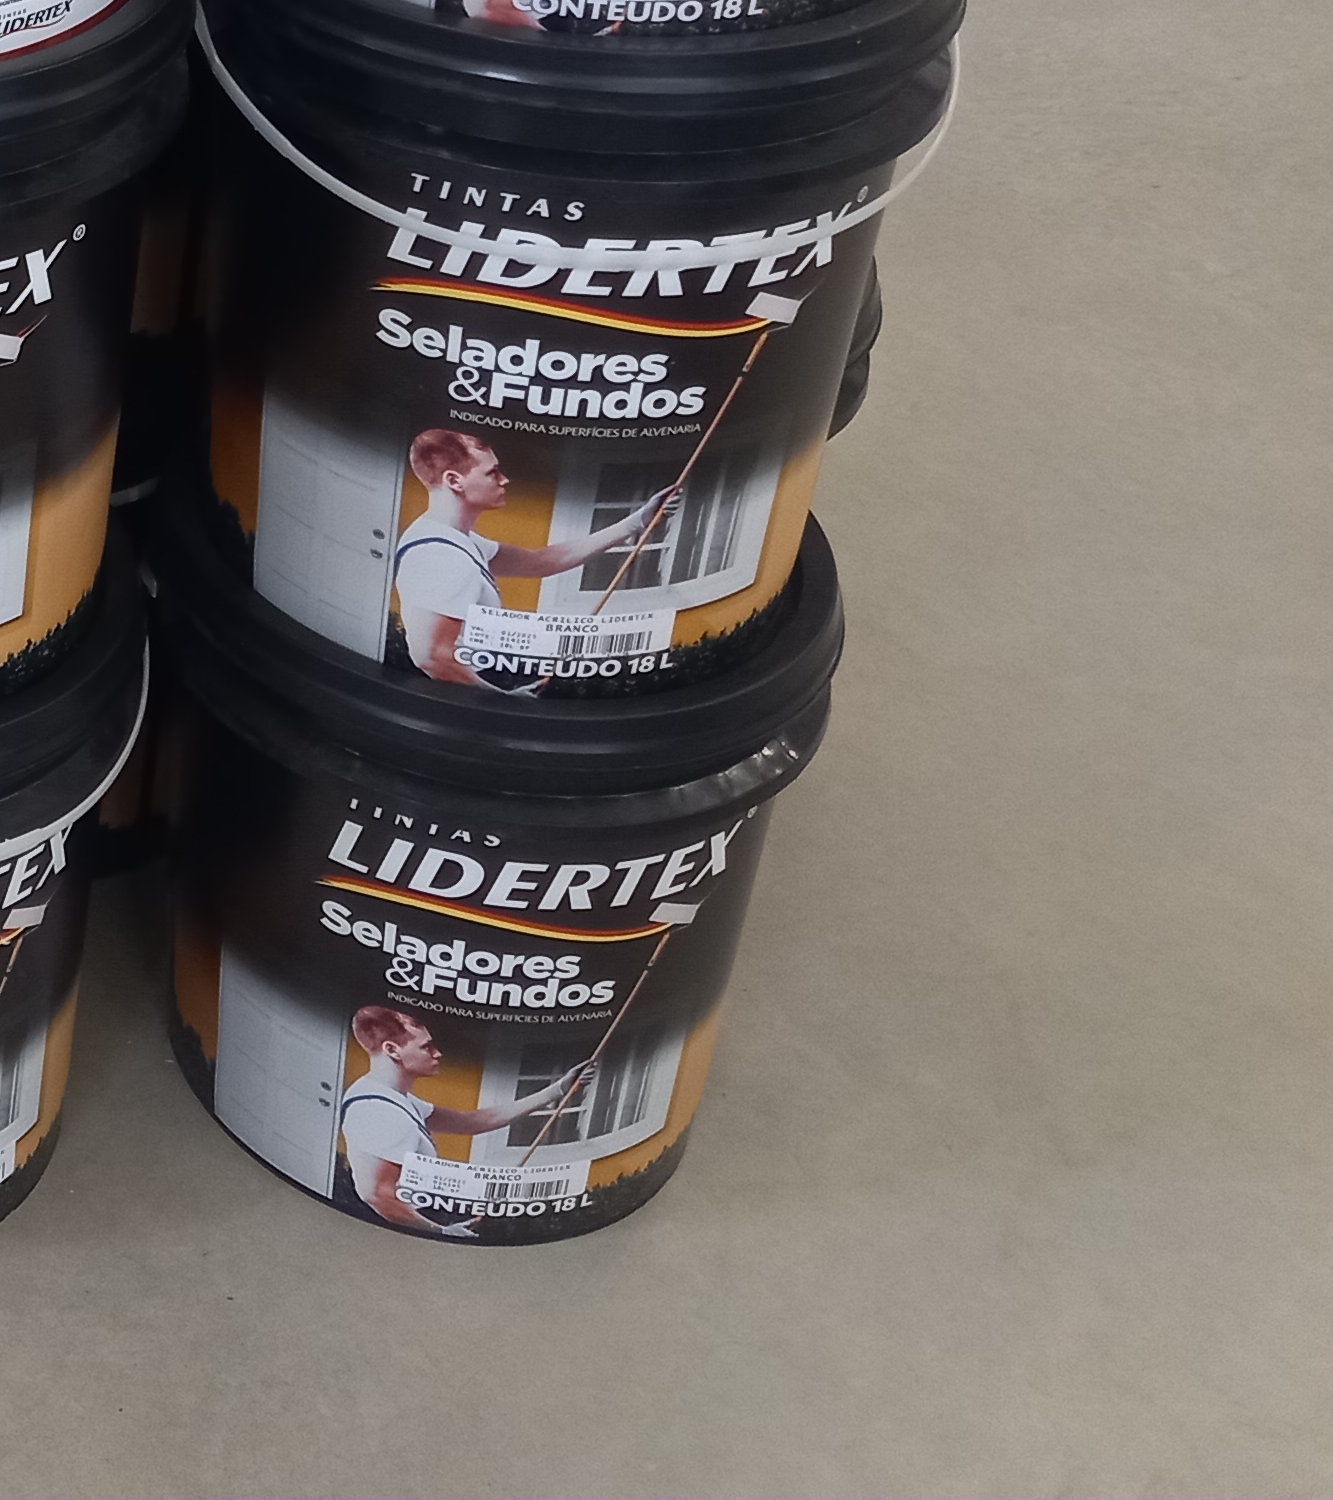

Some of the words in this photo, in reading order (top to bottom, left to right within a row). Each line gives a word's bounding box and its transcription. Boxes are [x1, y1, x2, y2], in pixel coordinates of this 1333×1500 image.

[711, 0, 742, 20] 18
[410, 172, 586, 223] TINTAS
[386, 203, 852, 298] LIDERTEX
[375, 307, 670, 385] Seladores
[450, 409, 512, 430] INDICADO
[514, 421, 546, 434] PARA
[548, 425, 619, 438] SUPERFÍCIES
[621, 428, 637, 438] DE
[640, 423, 701, 437] ALVENARIA
[545, 624, 599, 633] BRANCO
[627, 656, 655, 674] 18
[659, 652, 674, 670] L
[327, 818, 743, 912] LIDERTEX
[319, 900, 582, 980] Seladores
[387, 991, 443, 1012] INDICADO
[445, 1007, 473, 1018] PARA
[474, 1173, 522, 1181] BRANCO
[551, 1197, 577, 1213] 18
[580, 1193, 593, 1208] L
